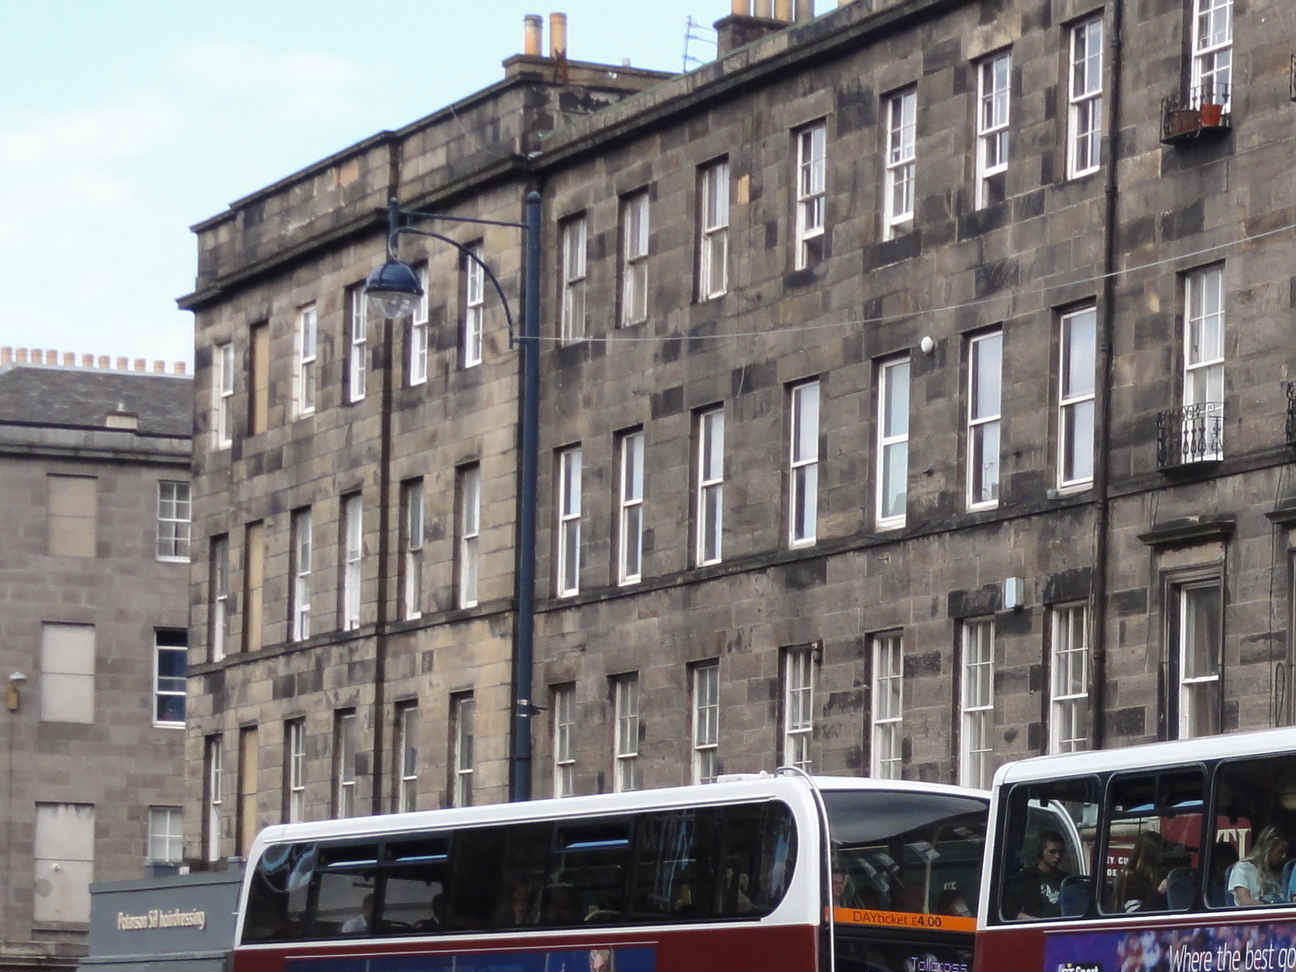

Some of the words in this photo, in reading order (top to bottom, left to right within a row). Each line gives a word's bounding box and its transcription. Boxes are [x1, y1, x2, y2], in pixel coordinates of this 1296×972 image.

[852, 911, 909, 925] DAYticket
[1169, 944, 1212, 972] Where
[1216, 942, 1241, 971] the
[1245, 942, 1274, 970] best
